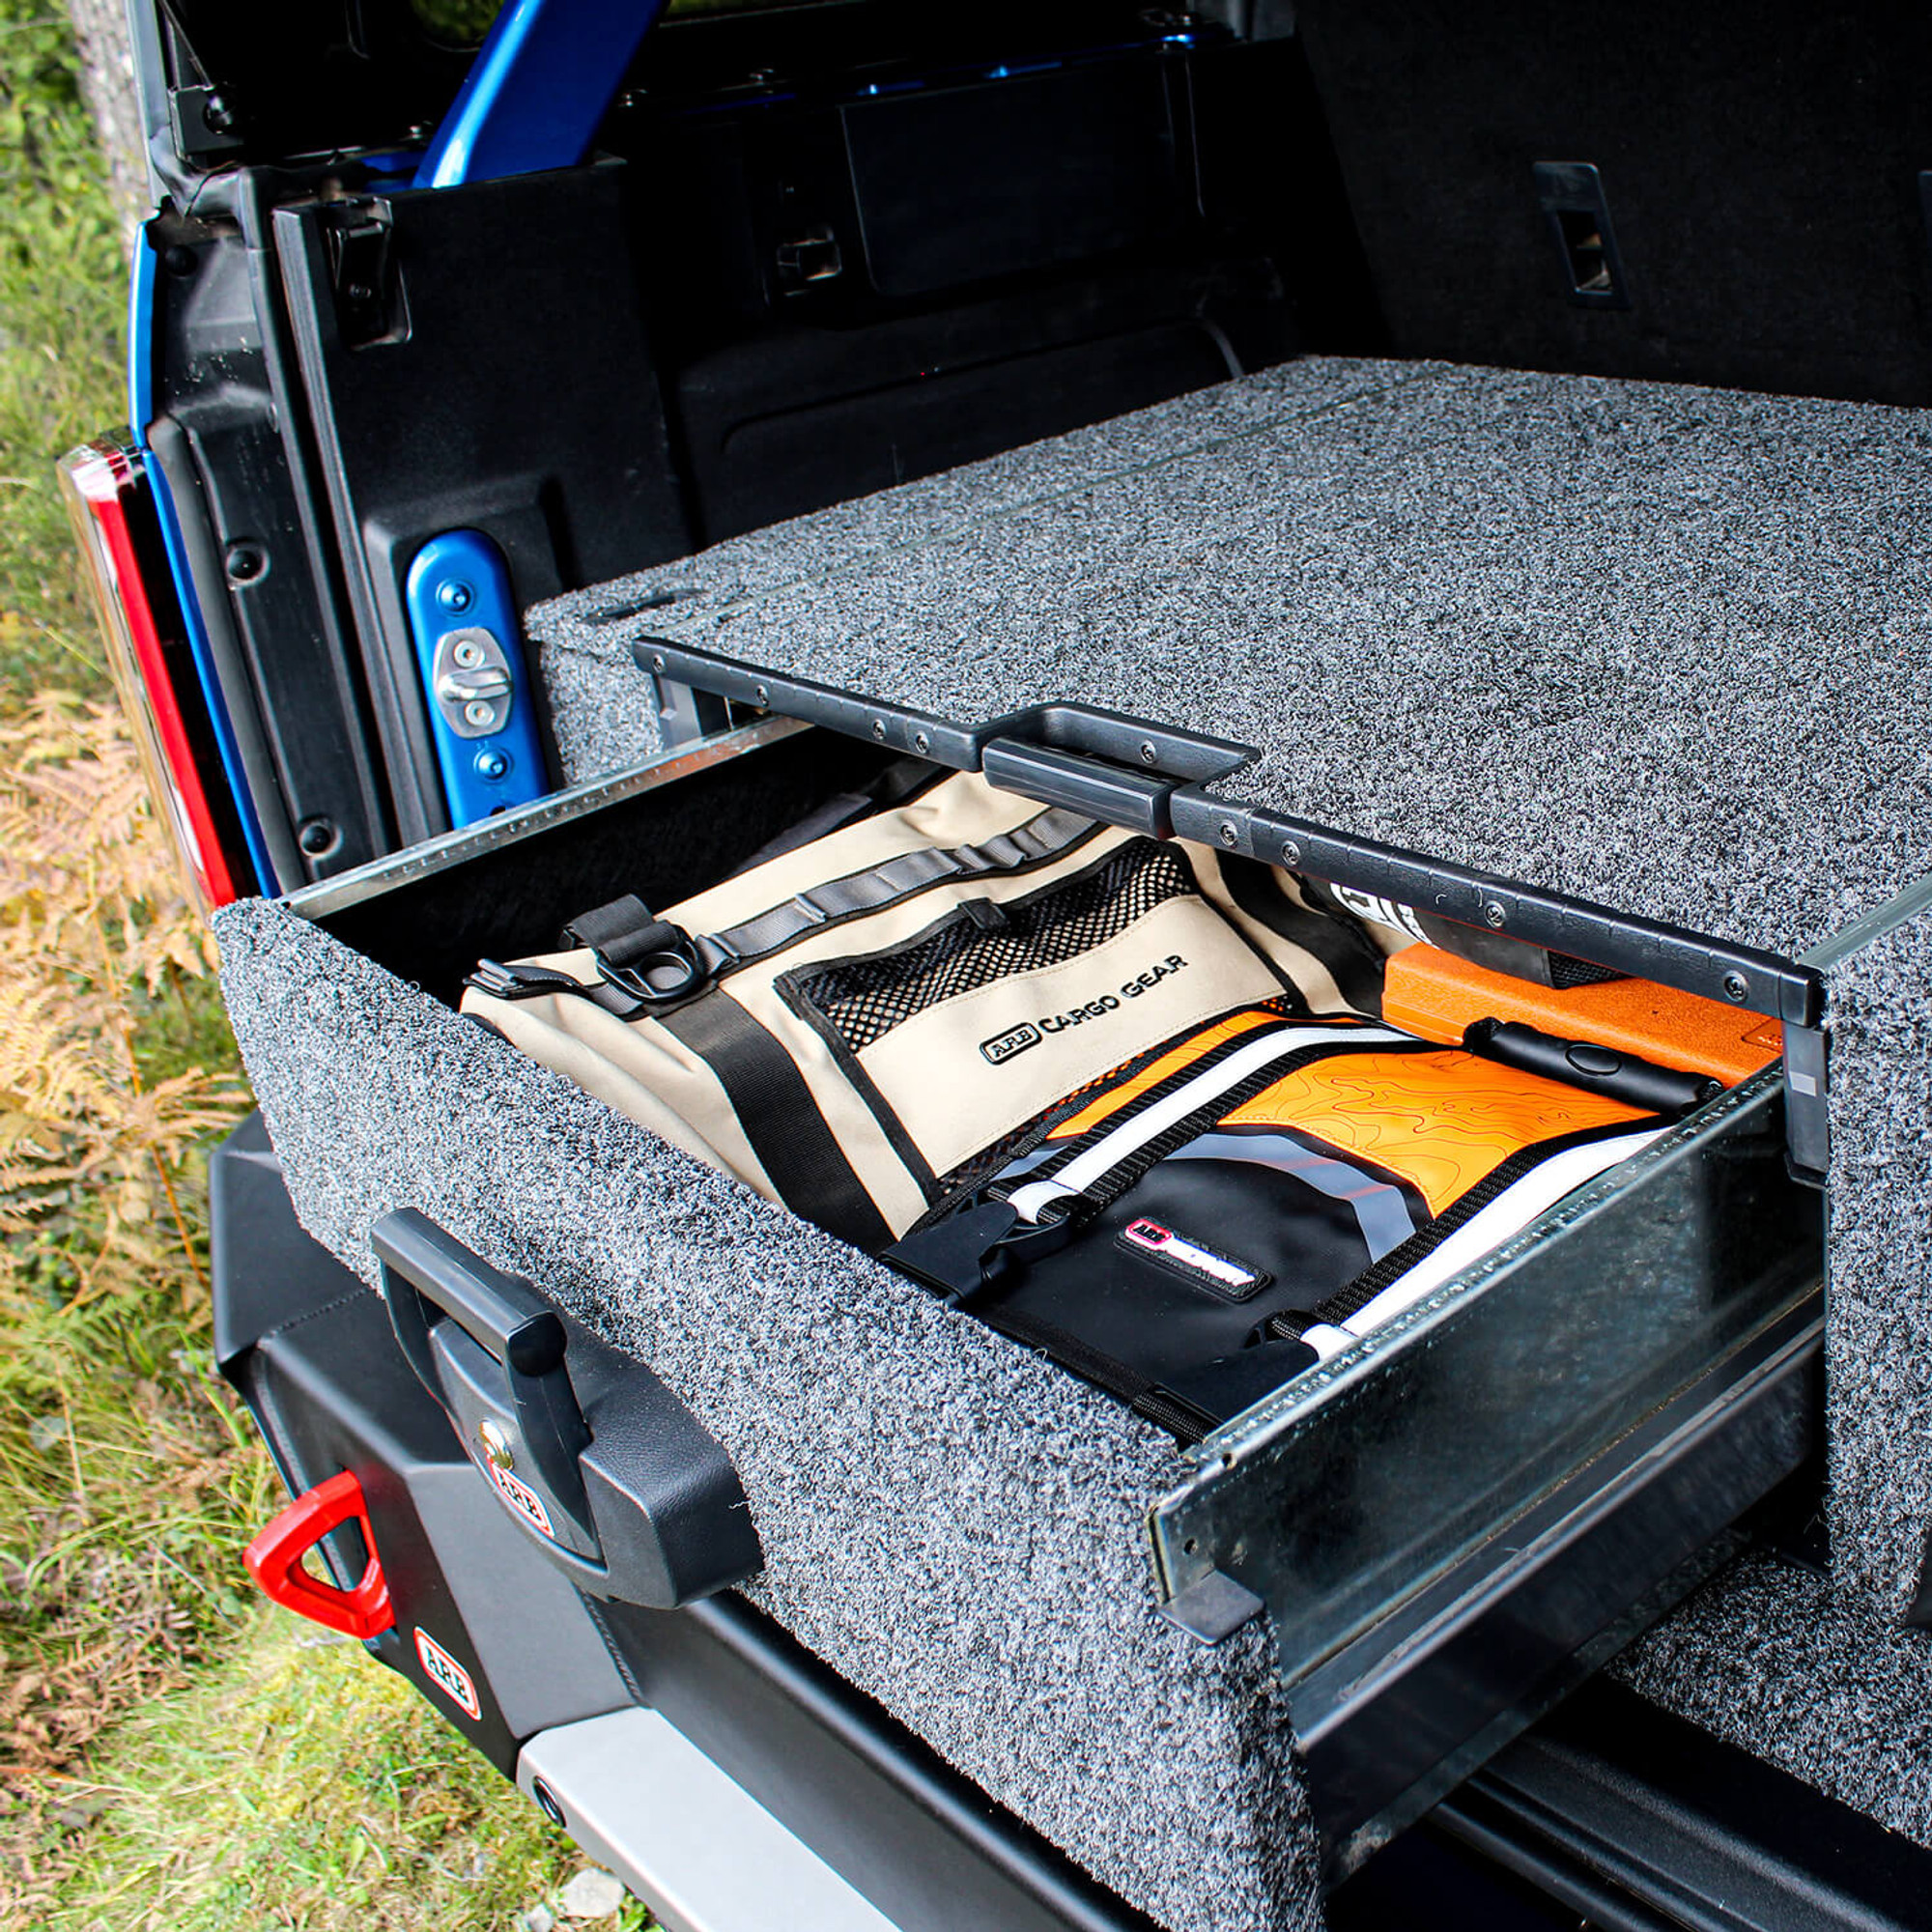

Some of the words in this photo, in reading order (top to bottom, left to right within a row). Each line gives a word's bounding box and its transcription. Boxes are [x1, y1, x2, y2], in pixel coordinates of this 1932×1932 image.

[990, 1029, 1034, 1058] ARB
[1037, 995, 1121, 1034] CARGO
[1120, 954, 1189, 999] GEAR
[497, 1471, 543, 1521] ARB
[425, 1645, 469, 1704] ARB
